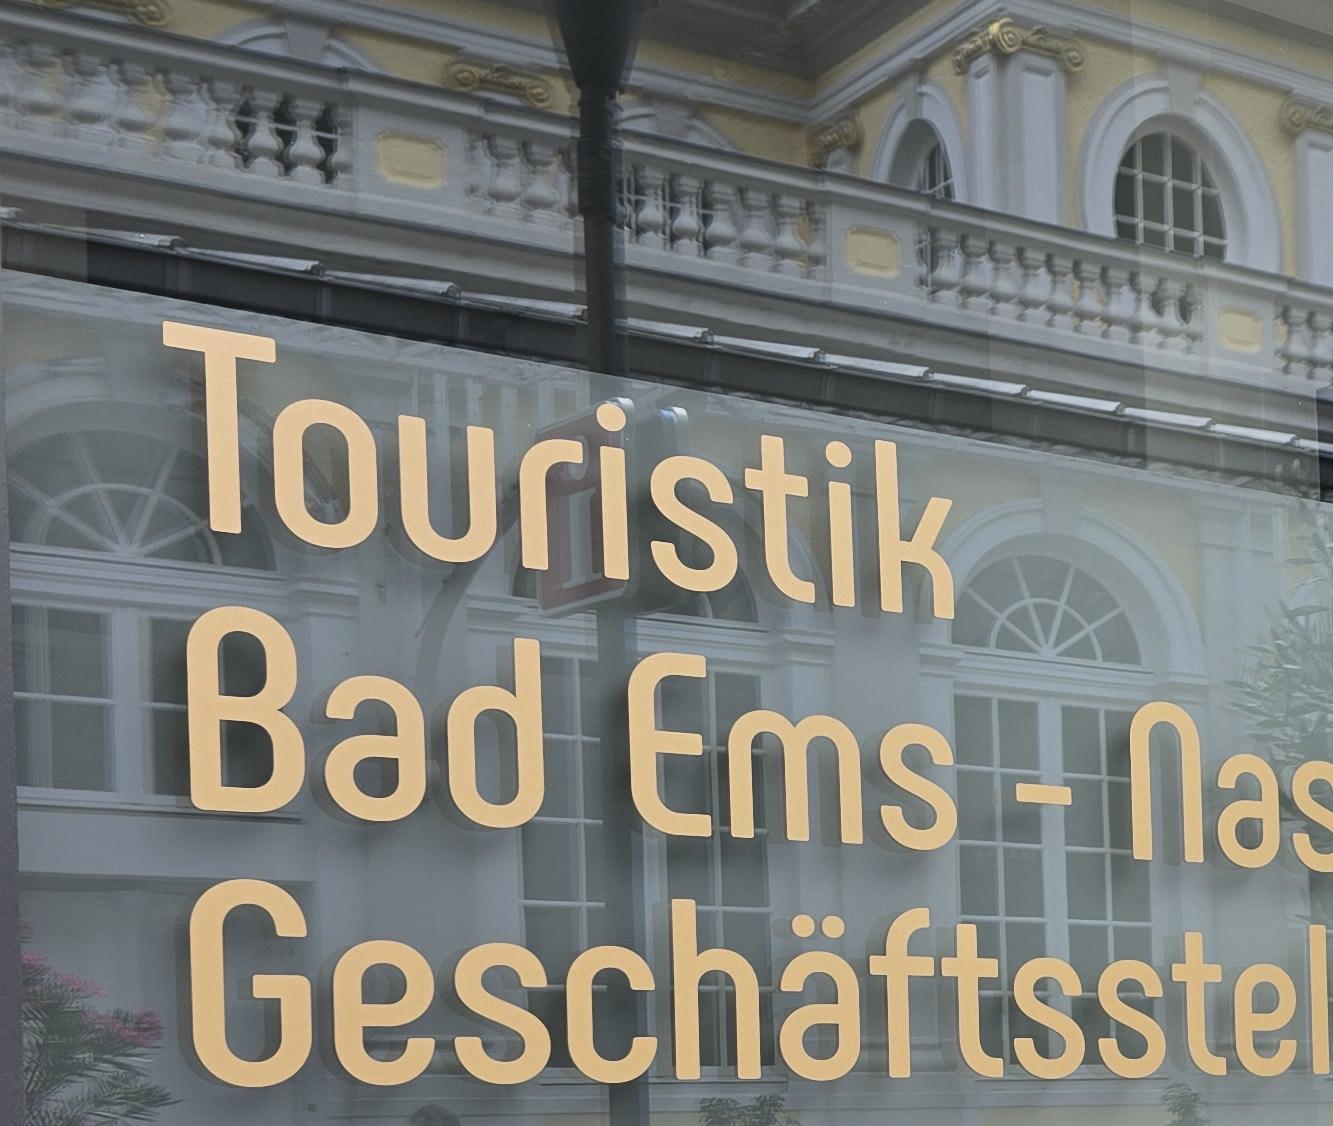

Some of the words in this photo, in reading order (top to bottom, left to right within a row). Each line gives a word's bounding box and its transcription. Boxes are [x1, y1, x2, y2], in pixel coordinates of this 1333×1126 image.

[162, 320, 955, 619] Touristik
[186, 605, 545, 828] Bad
[628, 652, 958, 851] Ems
